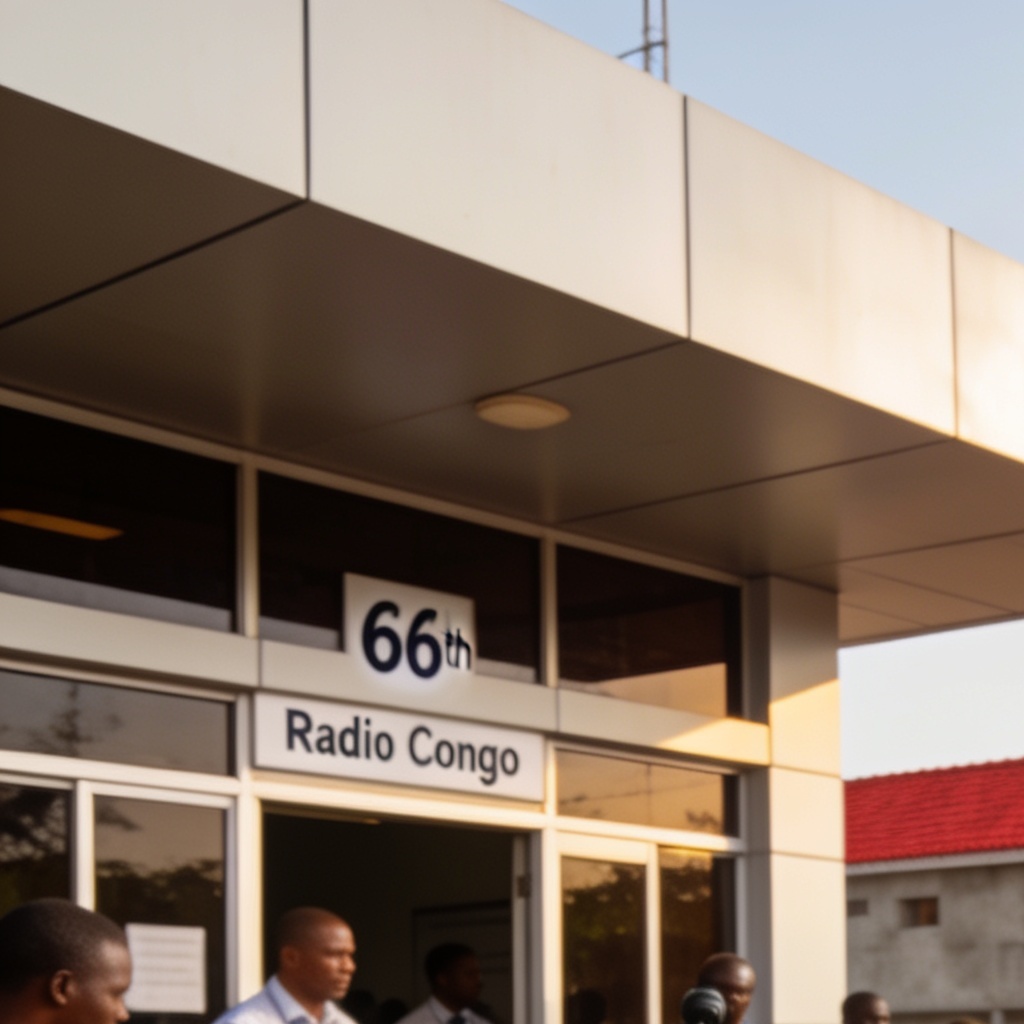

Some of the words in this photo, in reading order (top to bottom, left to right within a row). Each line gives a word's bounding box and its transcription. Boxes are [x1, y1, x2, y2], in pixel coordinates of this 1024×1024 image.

[362, 600, 471, 678] 66th
[286, 708, 394, 762] Radio
[409, 725, 520, 786] Congo
